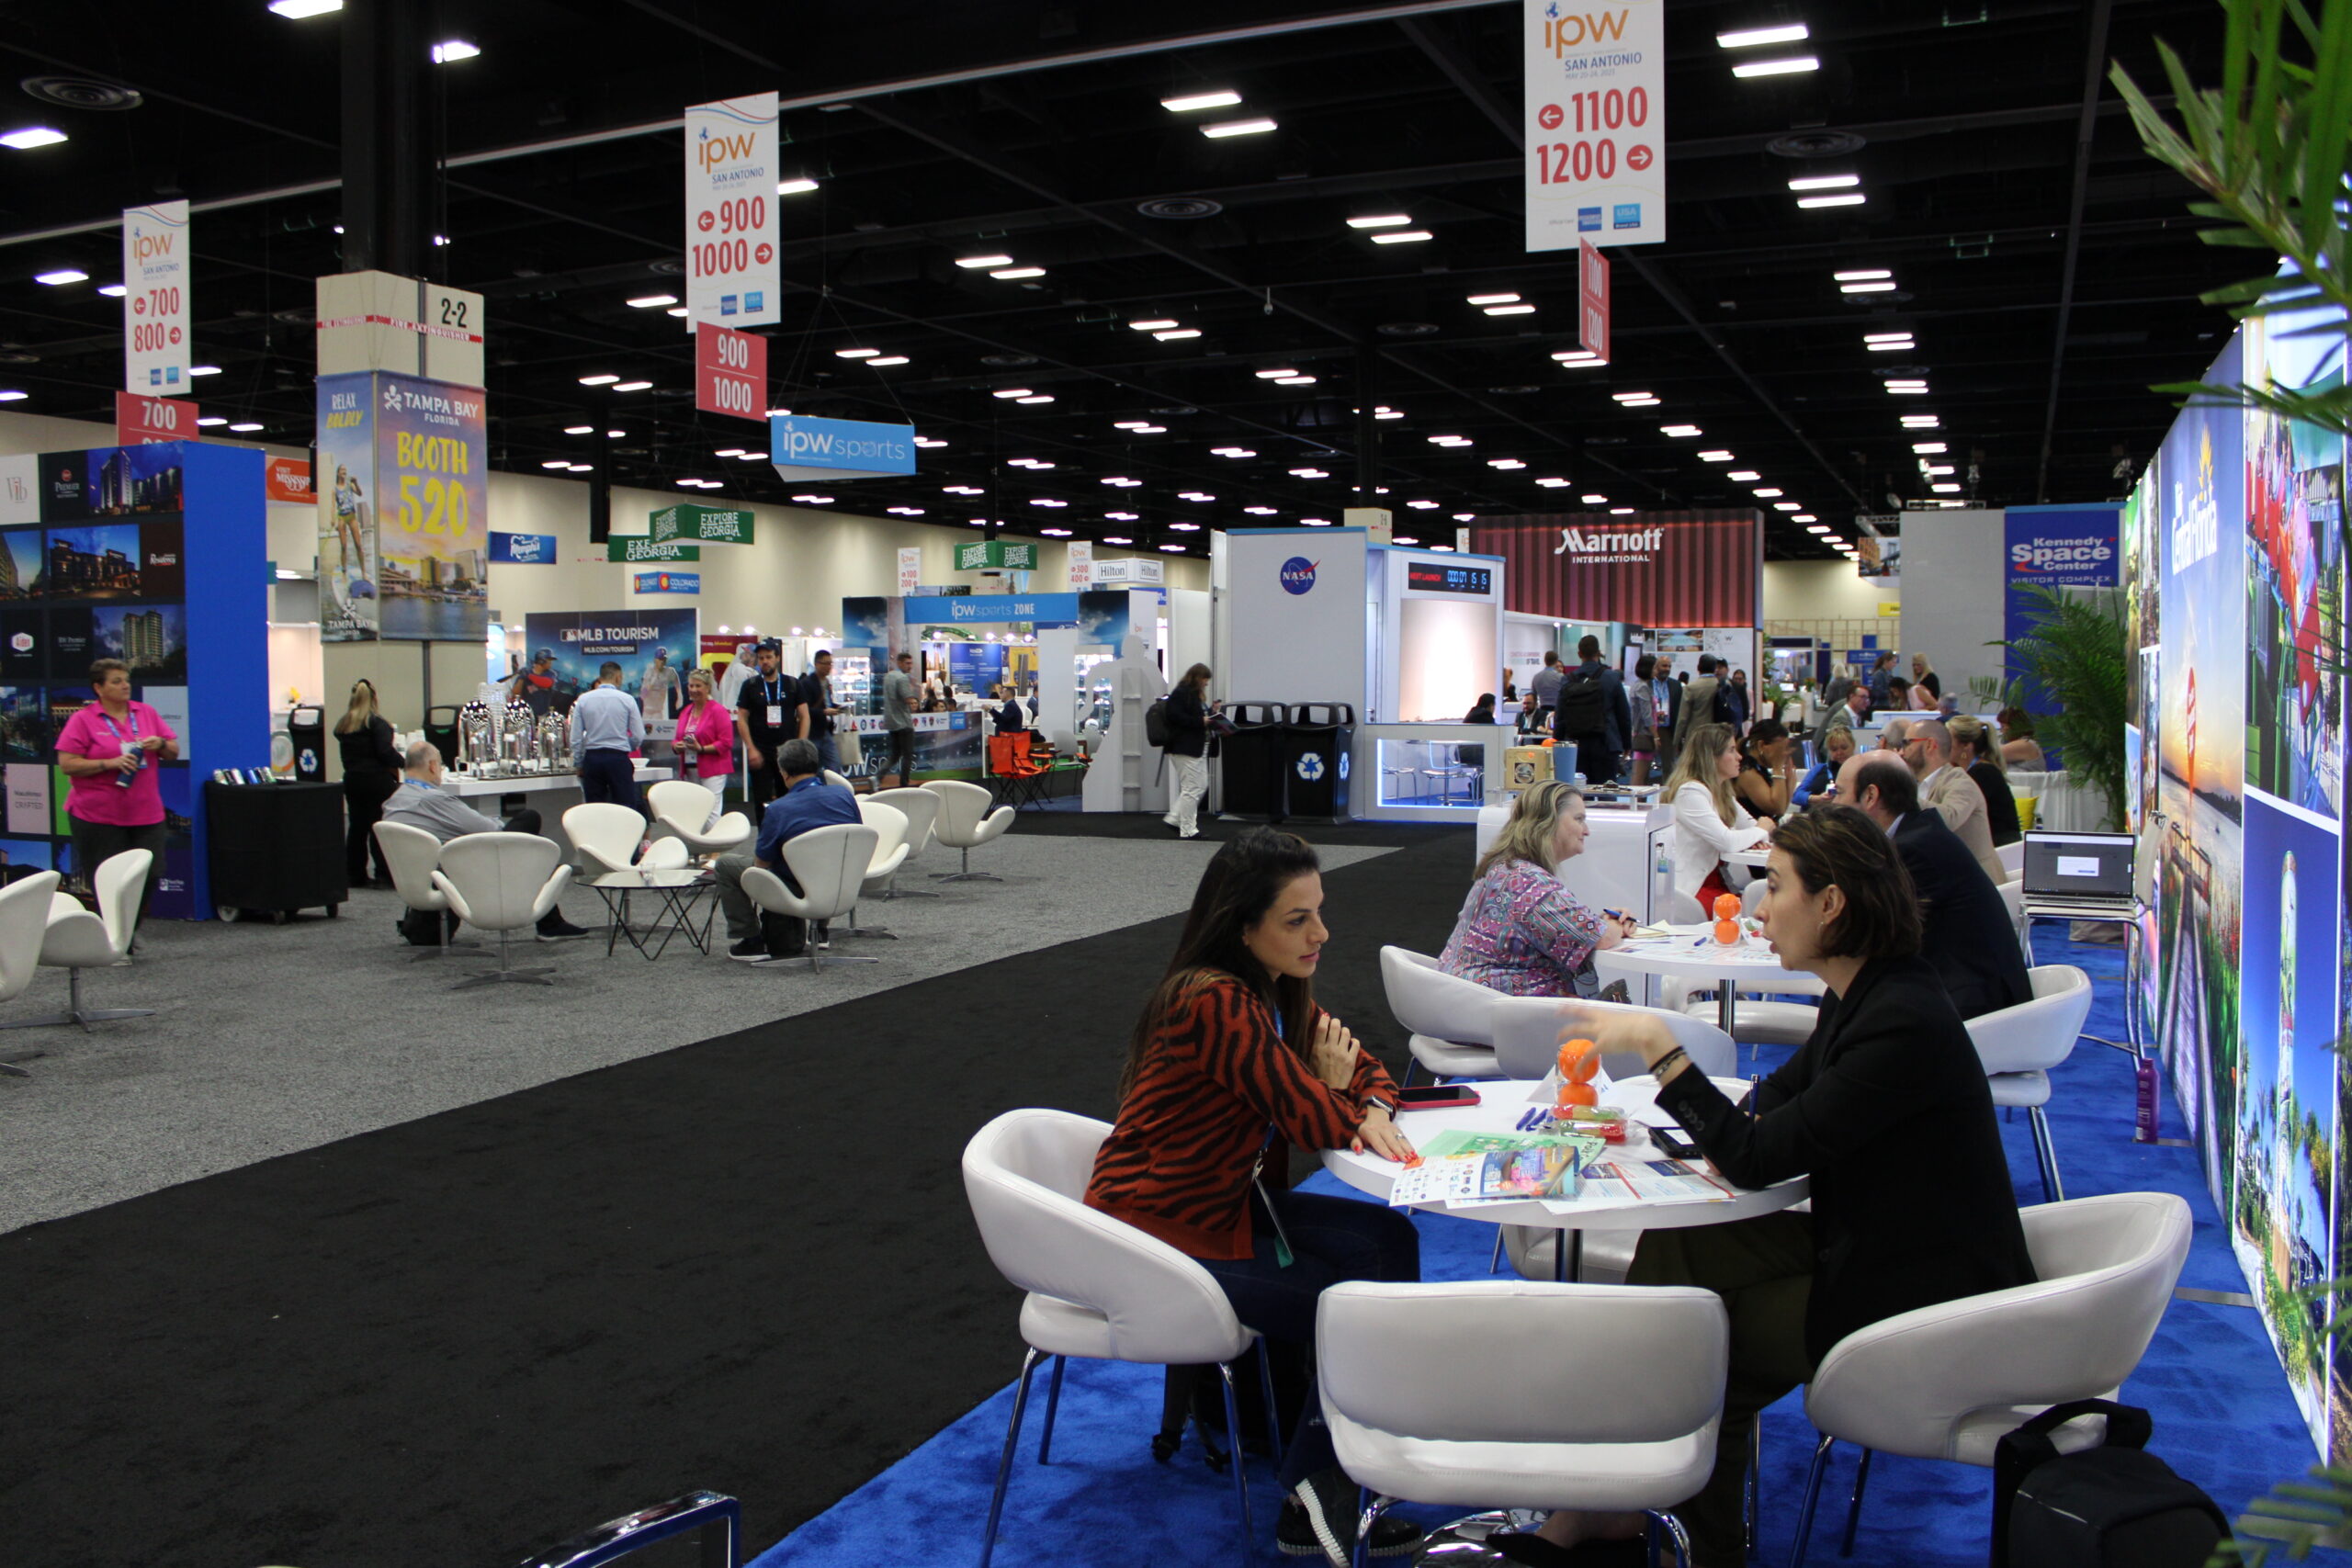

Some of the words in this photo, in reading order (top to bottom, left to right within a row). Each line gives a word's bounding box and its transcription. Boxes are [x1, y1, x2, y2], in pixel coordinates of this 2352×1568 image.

[1544, 7, 1630, 59] ipw
[1565, 58, 1588, 73] SAN
[1590, 51, 1643, 70] ANTONIO
[1571, 85, 1648, 133] 1100
[699, 131, 756, 175] ipw
[1536, 138, 1617, 185] 1200
[711, 172, 729, 185] SAN
[729, 166, 764, 183] ANTONIO
[719, 195, 765, 234] 900
[133, 232, 173, 266] ipw
[693, 238, 748, 277] 1000
[143, 266, 154, 276] SAN
[155, 263, 180, 273] ANTONIO
[149, 287, 180, 317] 700
[441, 298, 468, 328] 2-2
[134, 321, 165, 353] 800
[718, 333, 749, 369] 900
[332, 392, 356, 412] RELAX
[713, 376, 752, 413] 1000
[404, 391, 451, 415] TAMPA
[454, 400, 479, 419] BAY
[141, 400, 177, 431] 700
[325, 410, 364, 429] BOLDLY
[424, 412, 460, 427] FLORIDA
[396, 431, 469, 475] BOOTH
[398, 475, 469, 537] 520
[701, 512, 739, 525] EXPLORE
[699, 525, 741, 538] GEORGIA
[1554, 527, 1663, 555] Marriott
[2032, 536, 2104, 547] Kennedy
[626, 545, 683, 561] GEORGIA
[962, 543, 987, 557] EXPLORE
[1004, 545, 1029, 557] EXPLORE
[2011, 543, 2112, 566] Space
[961, 554, 989, 570] GEORGIA
[1003, 555, 1030, 568] GEORGIA
[1572, 554, 1651, 564] INTERNATIONAL
[2043, 561, 2097, 571] Center
[1076, 565, 1089, 573] 300
[1100, 565, 1125, 578] Hilton
[1140, 565, 1158, 577] Hilton
[1282, 570, 1314, 581] NASA
[670, 579, 699, 587] COLORADO
[1070, 574, 1083, 582] 400
[2058, 575, 2111, 583] COMPLEX
[1013, 603, 1035, 615] ZONE
[327, 619, 356, 630] TAMPA
[577, 627, 604, 642] MLB
[605, 626, 660, 641] TOURISM
